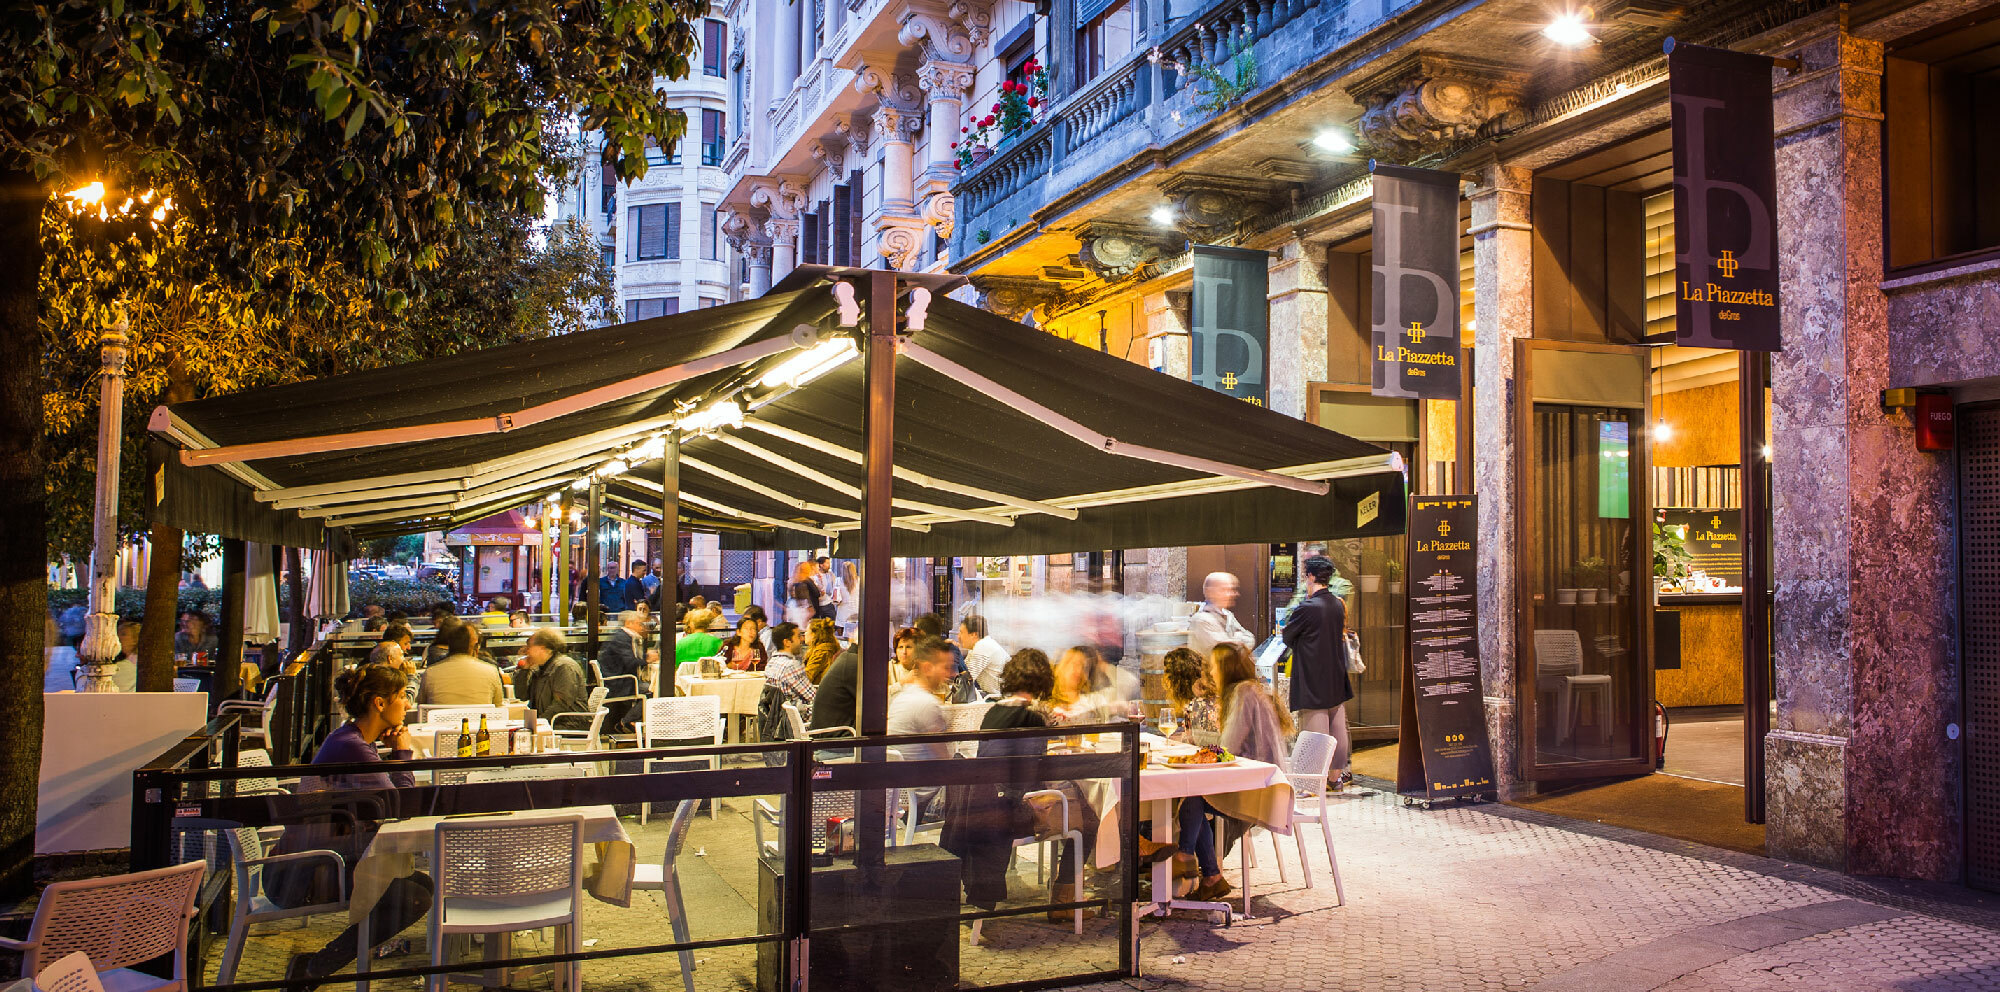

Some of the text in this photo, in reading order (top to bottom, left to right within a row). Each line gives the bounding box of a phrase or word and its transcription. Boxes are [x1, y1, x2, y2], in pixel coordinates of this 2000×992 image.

[1682, 281, 1774, 306] La Piazzetta
[1718, 309, 1741, 321] deGros
[1377, 345, 1456, 366] La Piazzetta
[1930, 412, 1952, 421] FUEGO
[1695, 530, 1737, 541] La Piazzetta
[1416, 540, 1471, 552] La Piazzetta
